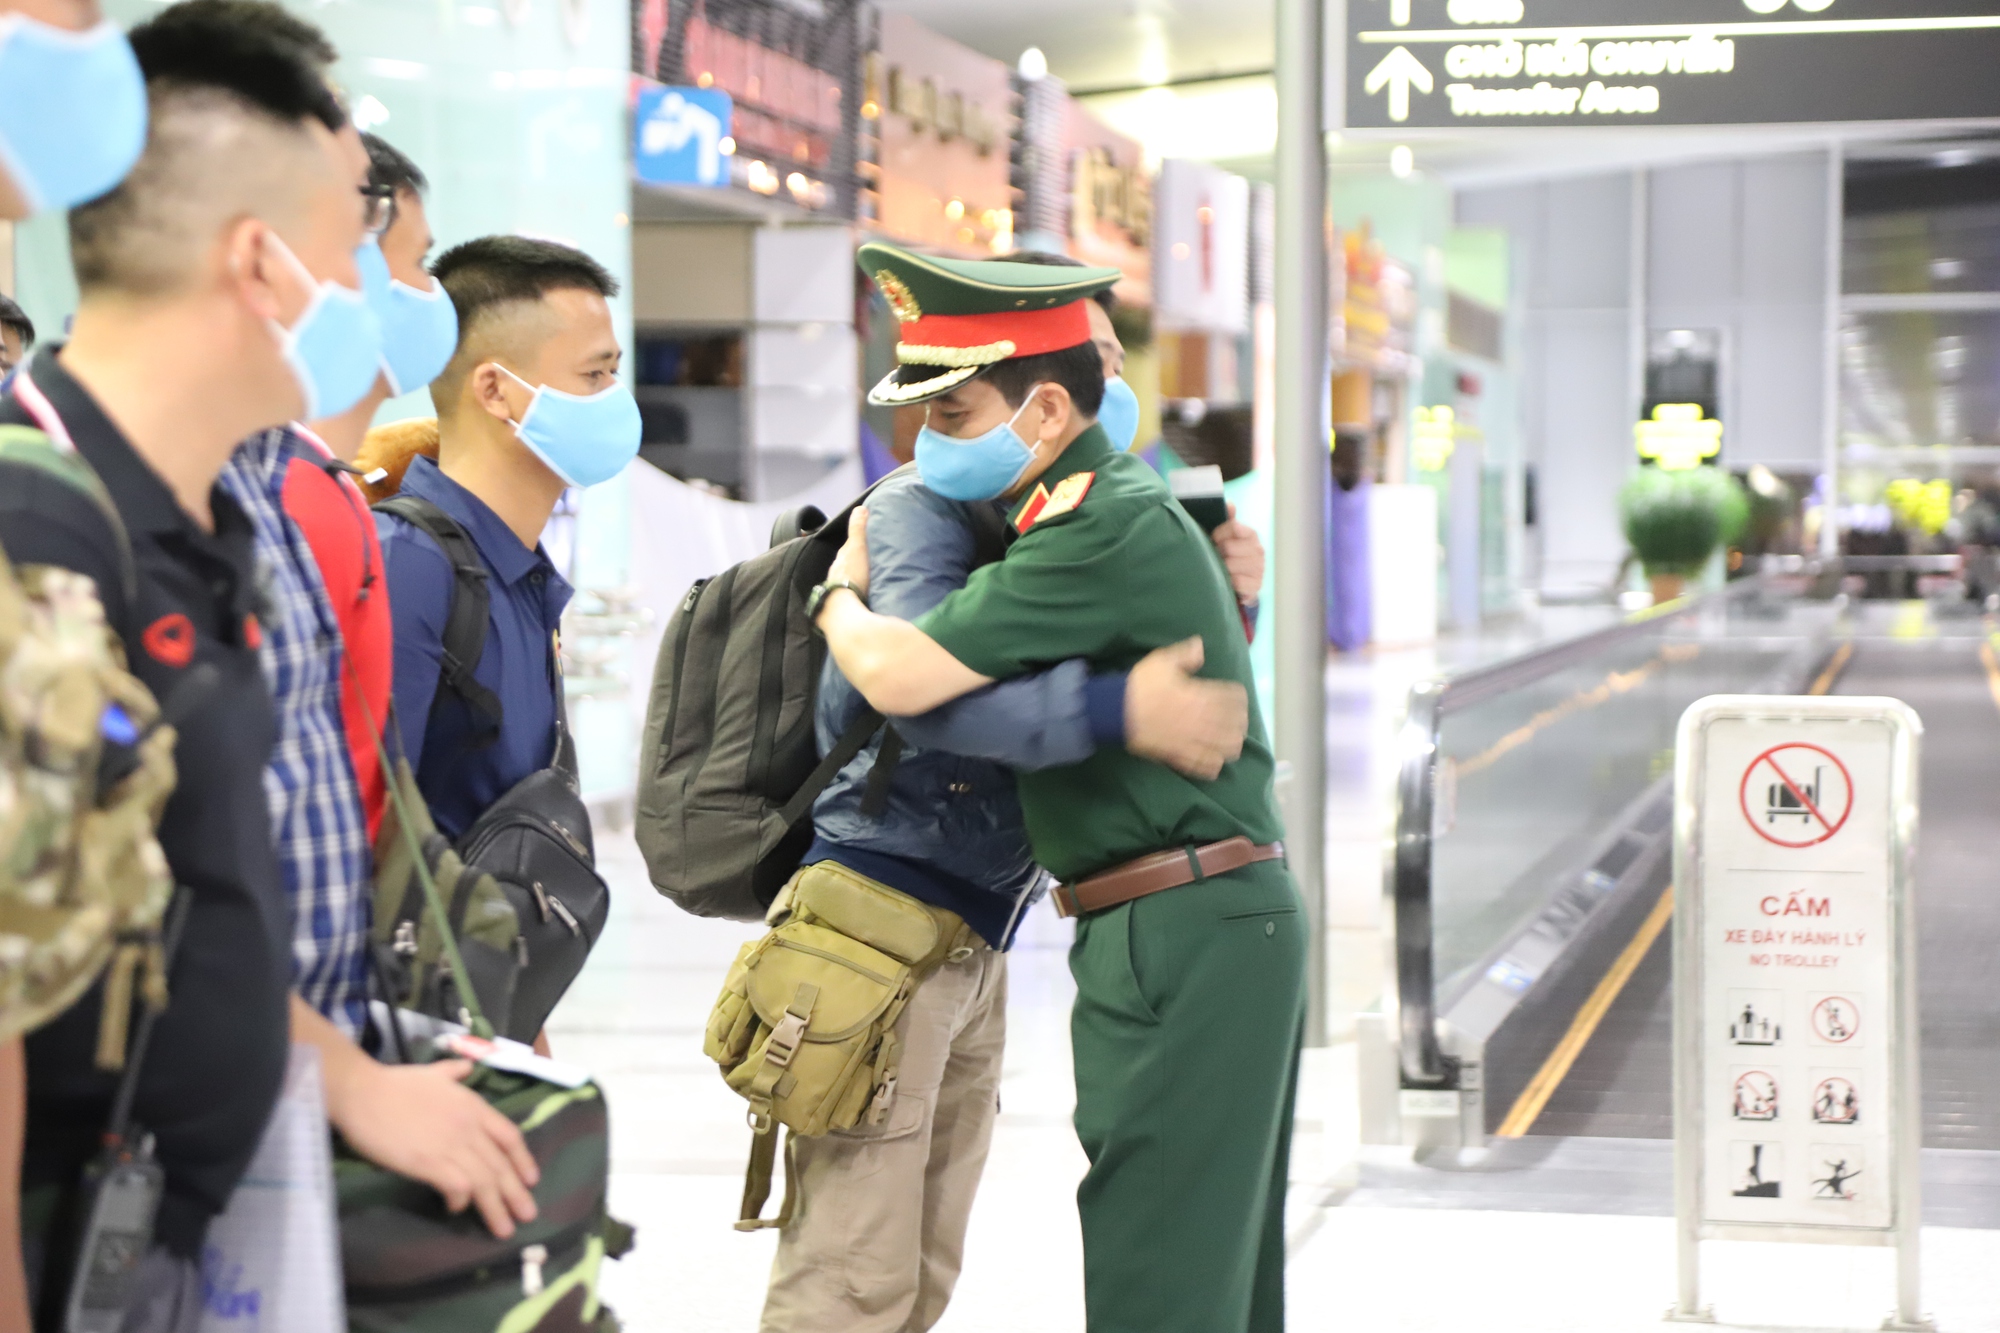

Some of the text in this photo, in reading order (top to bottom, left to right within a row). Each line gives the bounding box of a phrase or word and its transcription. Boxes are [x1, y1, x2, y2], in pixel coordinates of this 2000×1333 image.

[1446, 81, 1659, 115] Transfer Area
[1759, 888, 1830, 917] CẤM
[1725, 928, 1747, 943] XE
[1844, 928, 1867, 946] LÝ
[1749, 953, 1840, 967] NO TROLLEY
